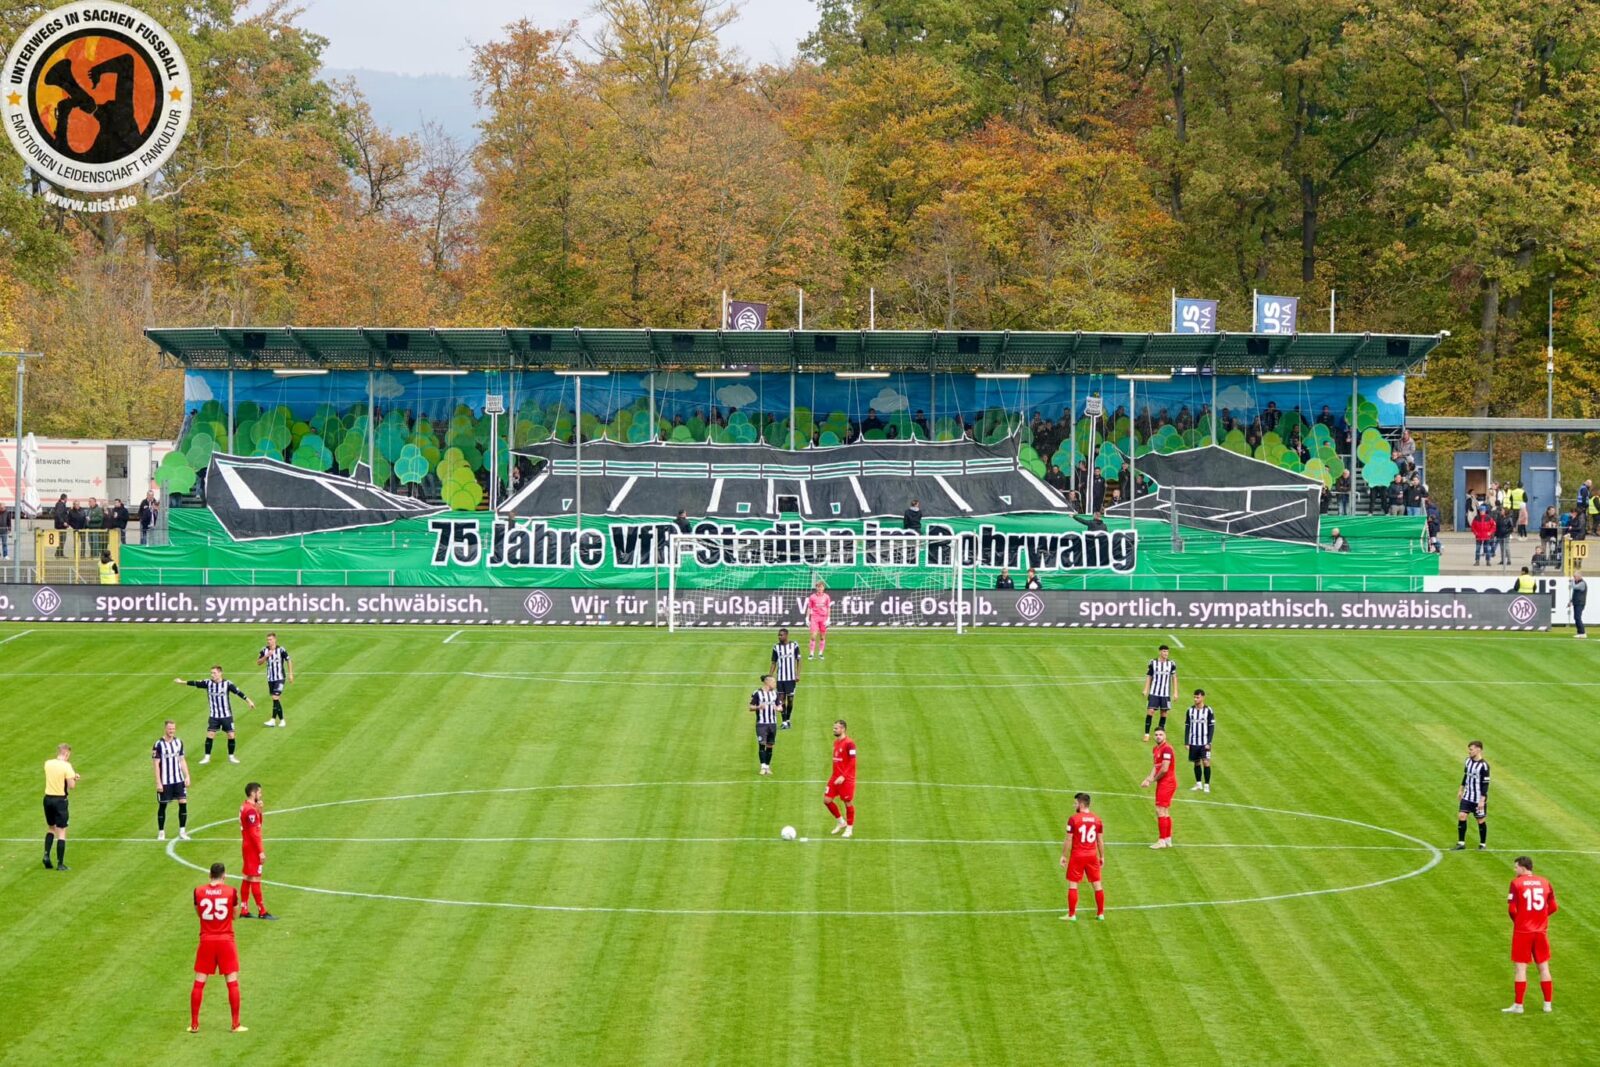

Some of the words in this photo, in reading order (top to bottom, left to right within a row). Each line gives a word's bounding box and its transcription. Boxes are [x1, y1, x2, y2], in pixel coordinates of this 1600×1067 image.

[48, 533, 55, 545] 8
[429, 520, 480, 566] 75
[487, 519, 606, 568] Jahre
[864, 521, 919, 567] im
[926, 524, 1138, 573] Rohrwang
[1575, 544, 1587, 557] 10
[96, 592, 199, 615] sportlich.
[205, 592, 351, 616] sympathisch.
[357, 593, 489, 613] schwäbisch.
[570, 595, 609, 614] Wir
[616, 595, 648, 614] für
[656, 595, 695, 614] den
[703, 595, 789, 615] Fußball.
[842, 596, 874, 615] für
[881, 596, 913, 615] die
[920, 595, 998, 616] Ostalb.
[1079, 597, 1182, 620] sportlich.
[1189, 598, 1334, 621] sympathisch.
[1341, 599, 1473, 619] schwäbisch.
[1078, 824, 1097, 843] 16
[200, 898, 228, 920] 25
[1522, 888, 1545, 911] 15
